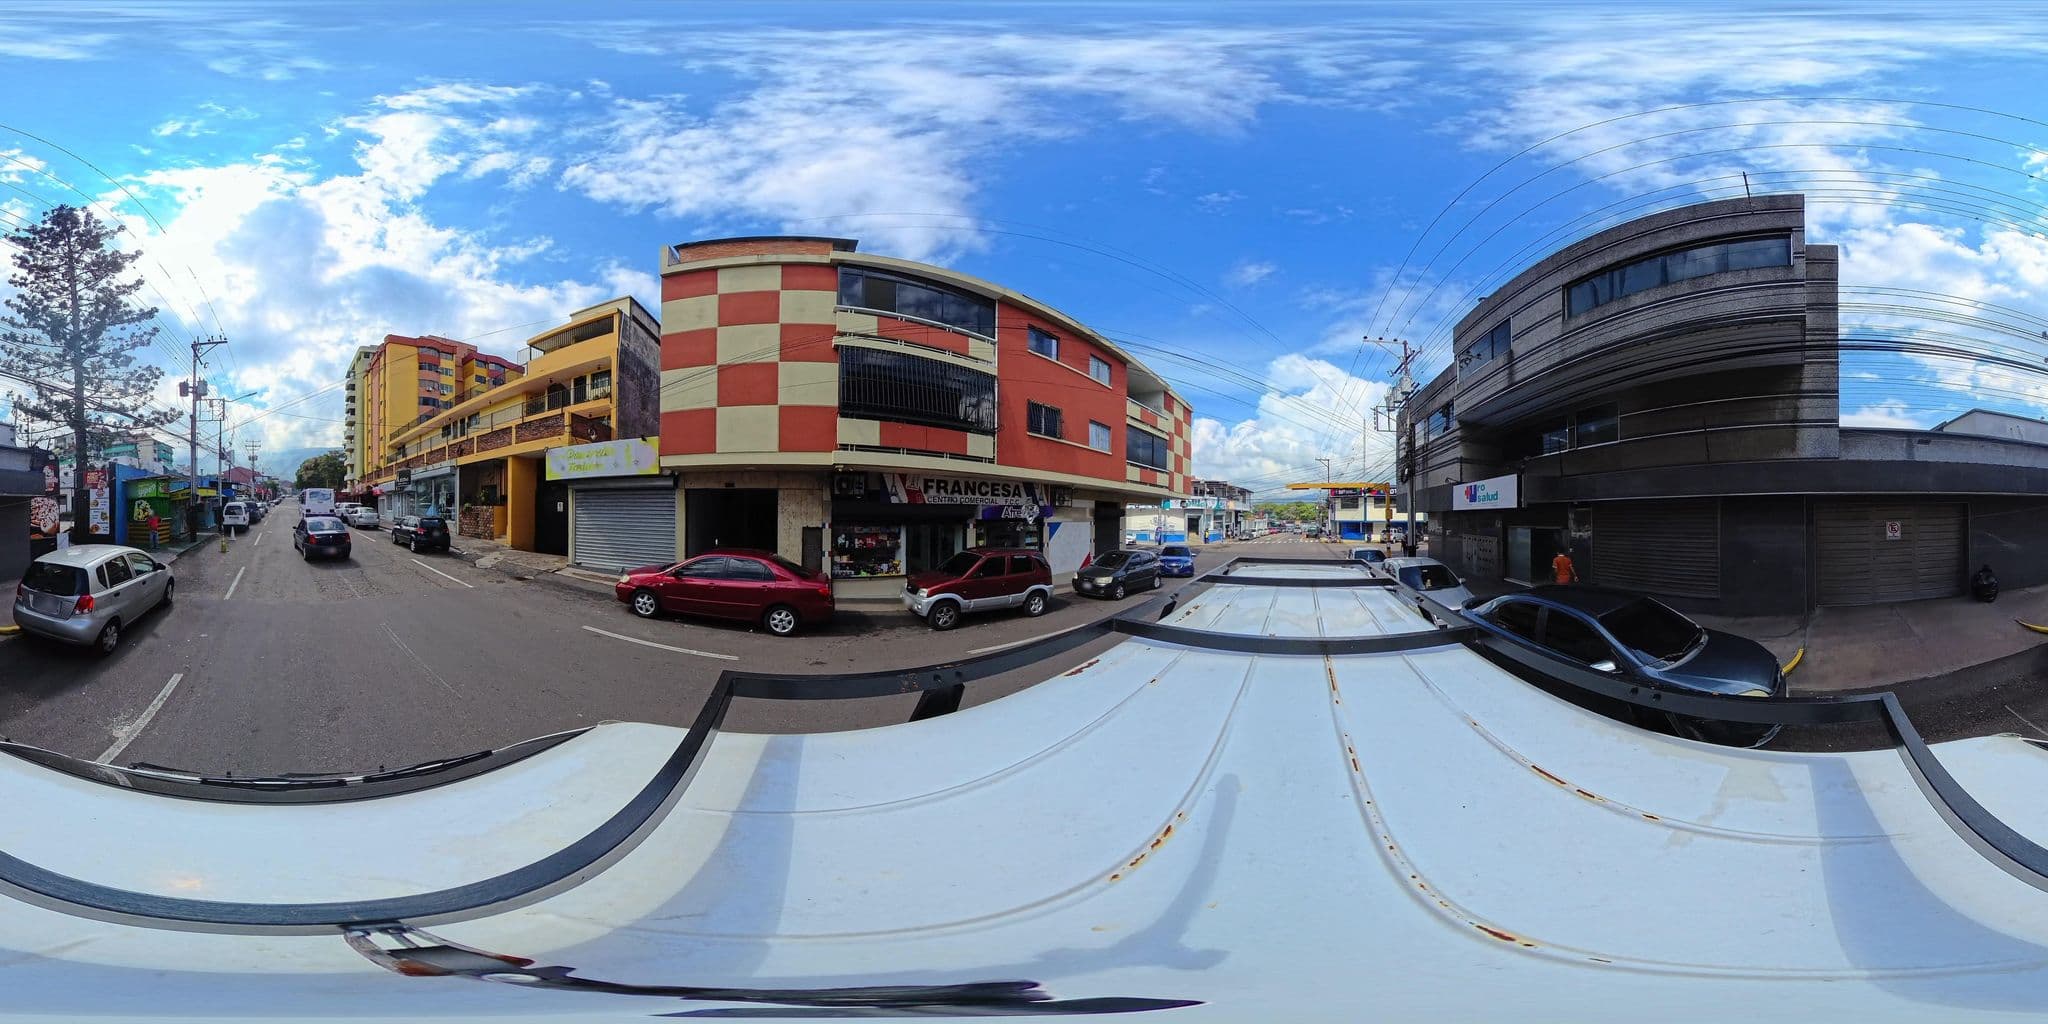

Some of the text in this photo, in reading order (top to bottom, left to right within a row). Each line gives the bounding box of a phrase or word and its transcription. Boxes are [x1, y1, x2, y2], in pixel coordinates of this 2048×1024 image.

[923, 478, 1022, 498] FRANCESA
[928, 496, 958, 504] CENTRO
[960, 497, 999, 505] COMERCIAL
[1477, 490, 1498, 502] salud
